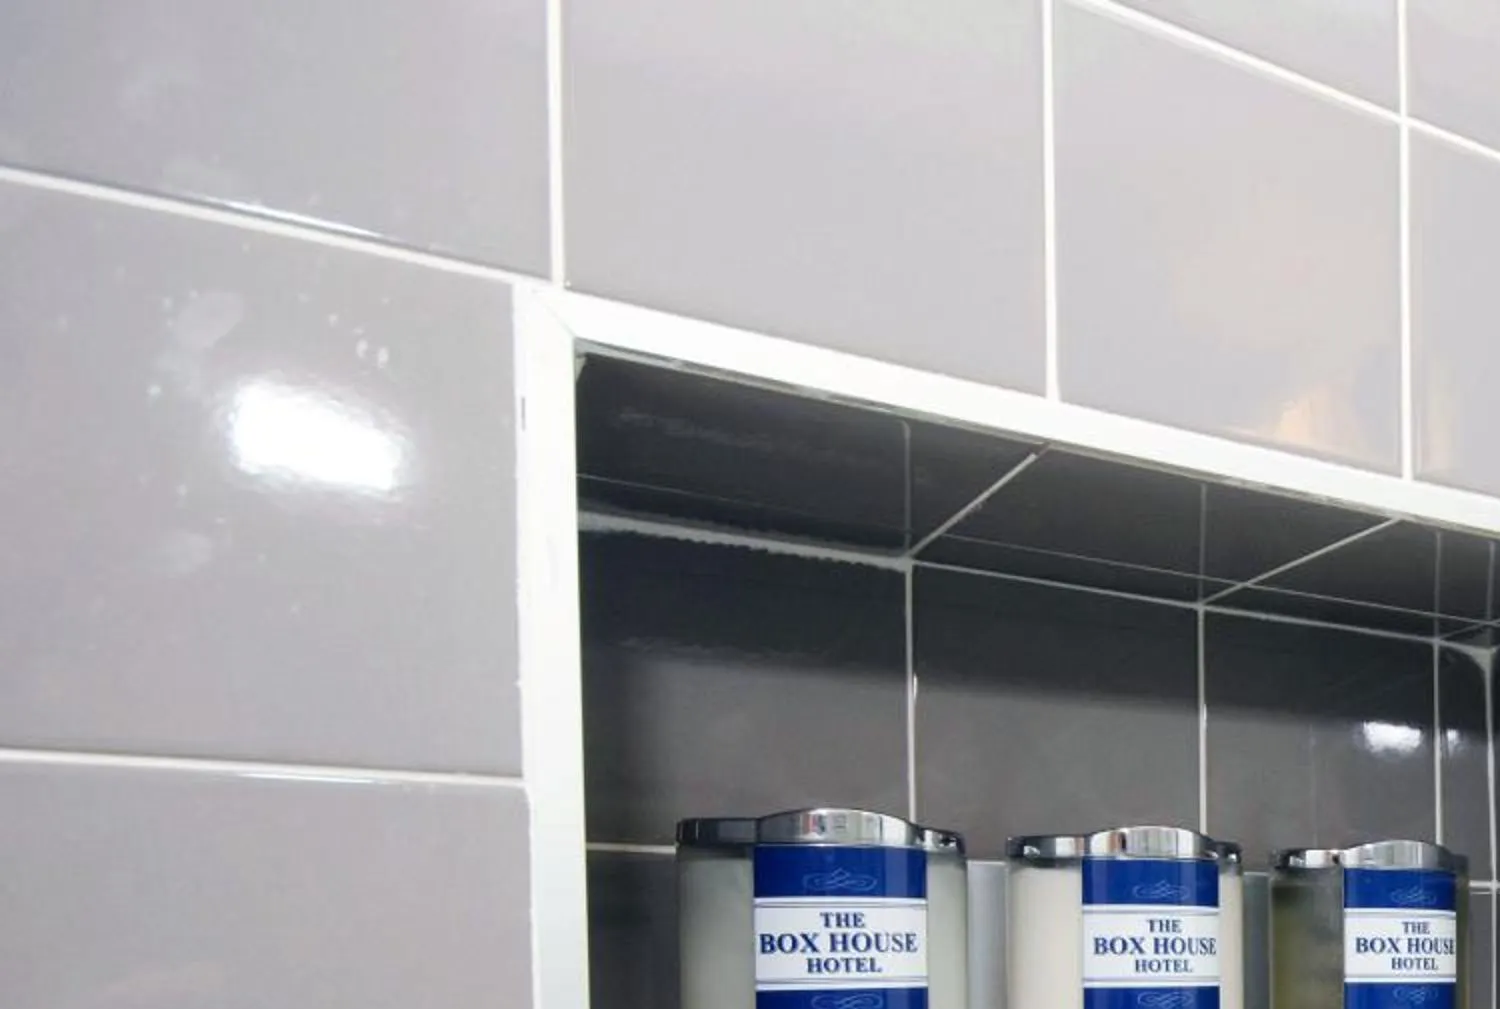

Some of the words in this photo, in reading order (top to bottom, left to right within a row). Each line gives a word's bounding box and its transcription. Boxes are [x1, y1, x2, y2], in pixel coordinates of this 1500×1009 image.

[820, 911, 865, 928] THE
[1147, 919, 1182, 933] THE
[1402, 921, 1430, 934] THE
[759, 933, 819, 954] BOX
[829, 932, 918, 952] HOUSE
[1093, 936, 1145, 955] BOX
[1153, 936, 1217, 955] HOUSE
[1355, 936, 1401, 954] BOX
[806, 957, 882, 973] HOTEL
[1135, 959, 1193, 973] HOTEL
[1391, 957, 1439, 970] HOTEL
